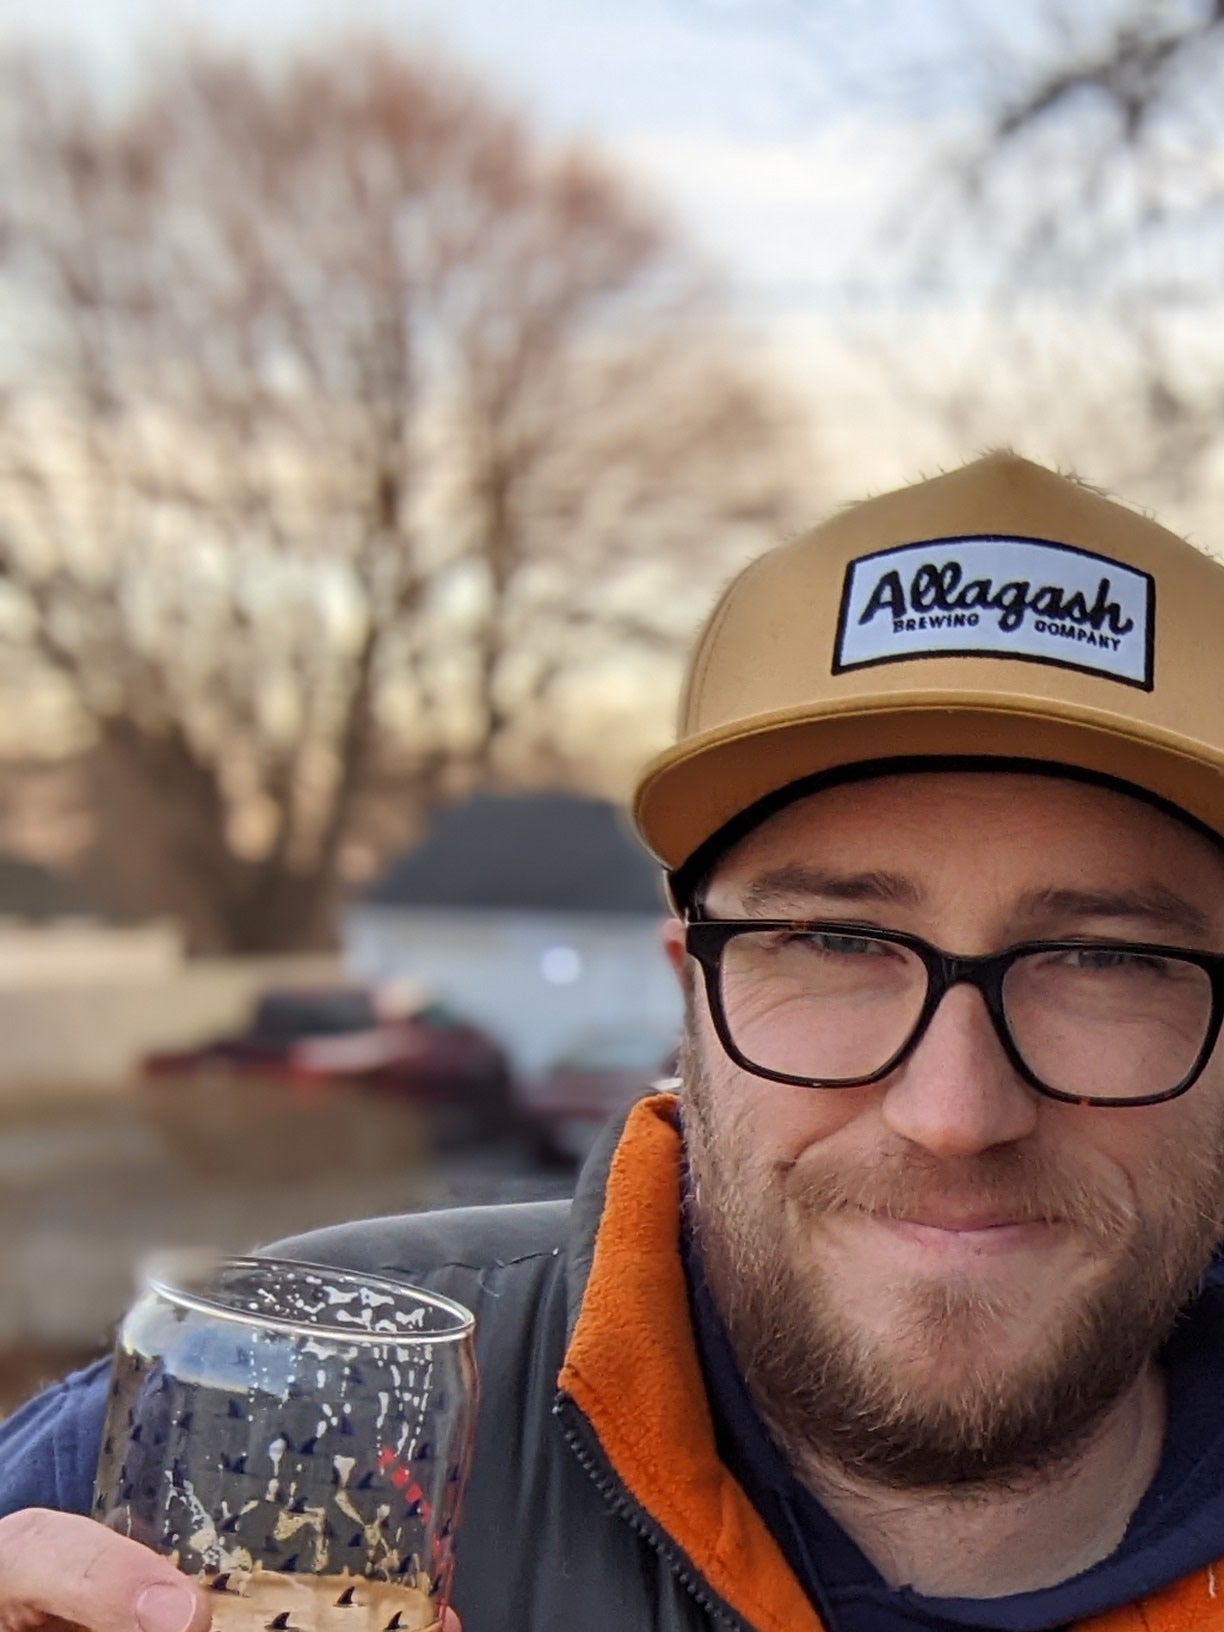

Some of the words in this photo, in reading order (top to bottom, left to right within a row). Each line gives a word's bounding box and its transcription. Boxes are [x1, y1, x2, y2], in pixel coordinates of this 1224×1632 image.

[858, 561, 1134, 634] Allagash
[893, 612, 980, 634] BREWING
[1033, 620, 1121, 652] COMPANY
